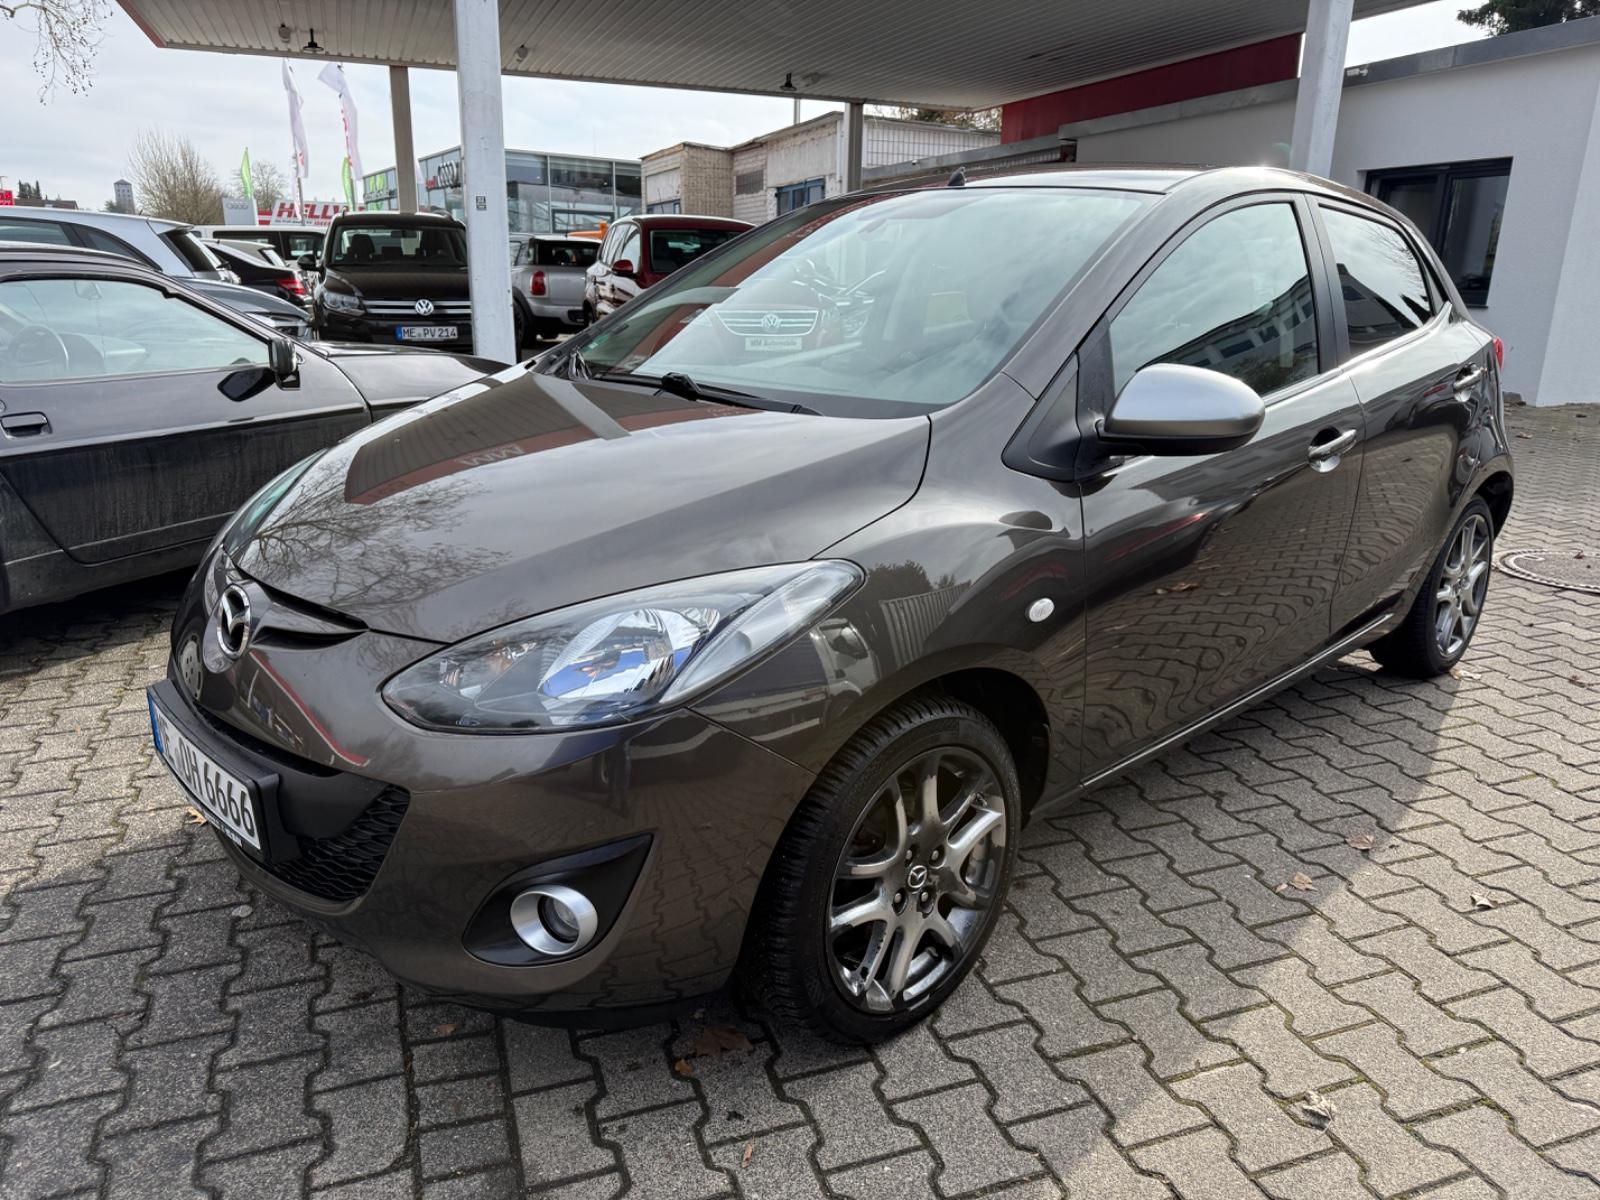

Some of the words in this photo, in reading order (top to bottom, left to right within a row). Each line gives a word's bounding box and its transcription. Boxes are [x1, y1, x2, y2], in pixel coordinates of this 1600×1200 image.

[402, 326, 417, 338] ME
[423, 326, 436, 338] PV
[438, 327, 456, 338] 214
[203, 761, 255, 838] 6666
